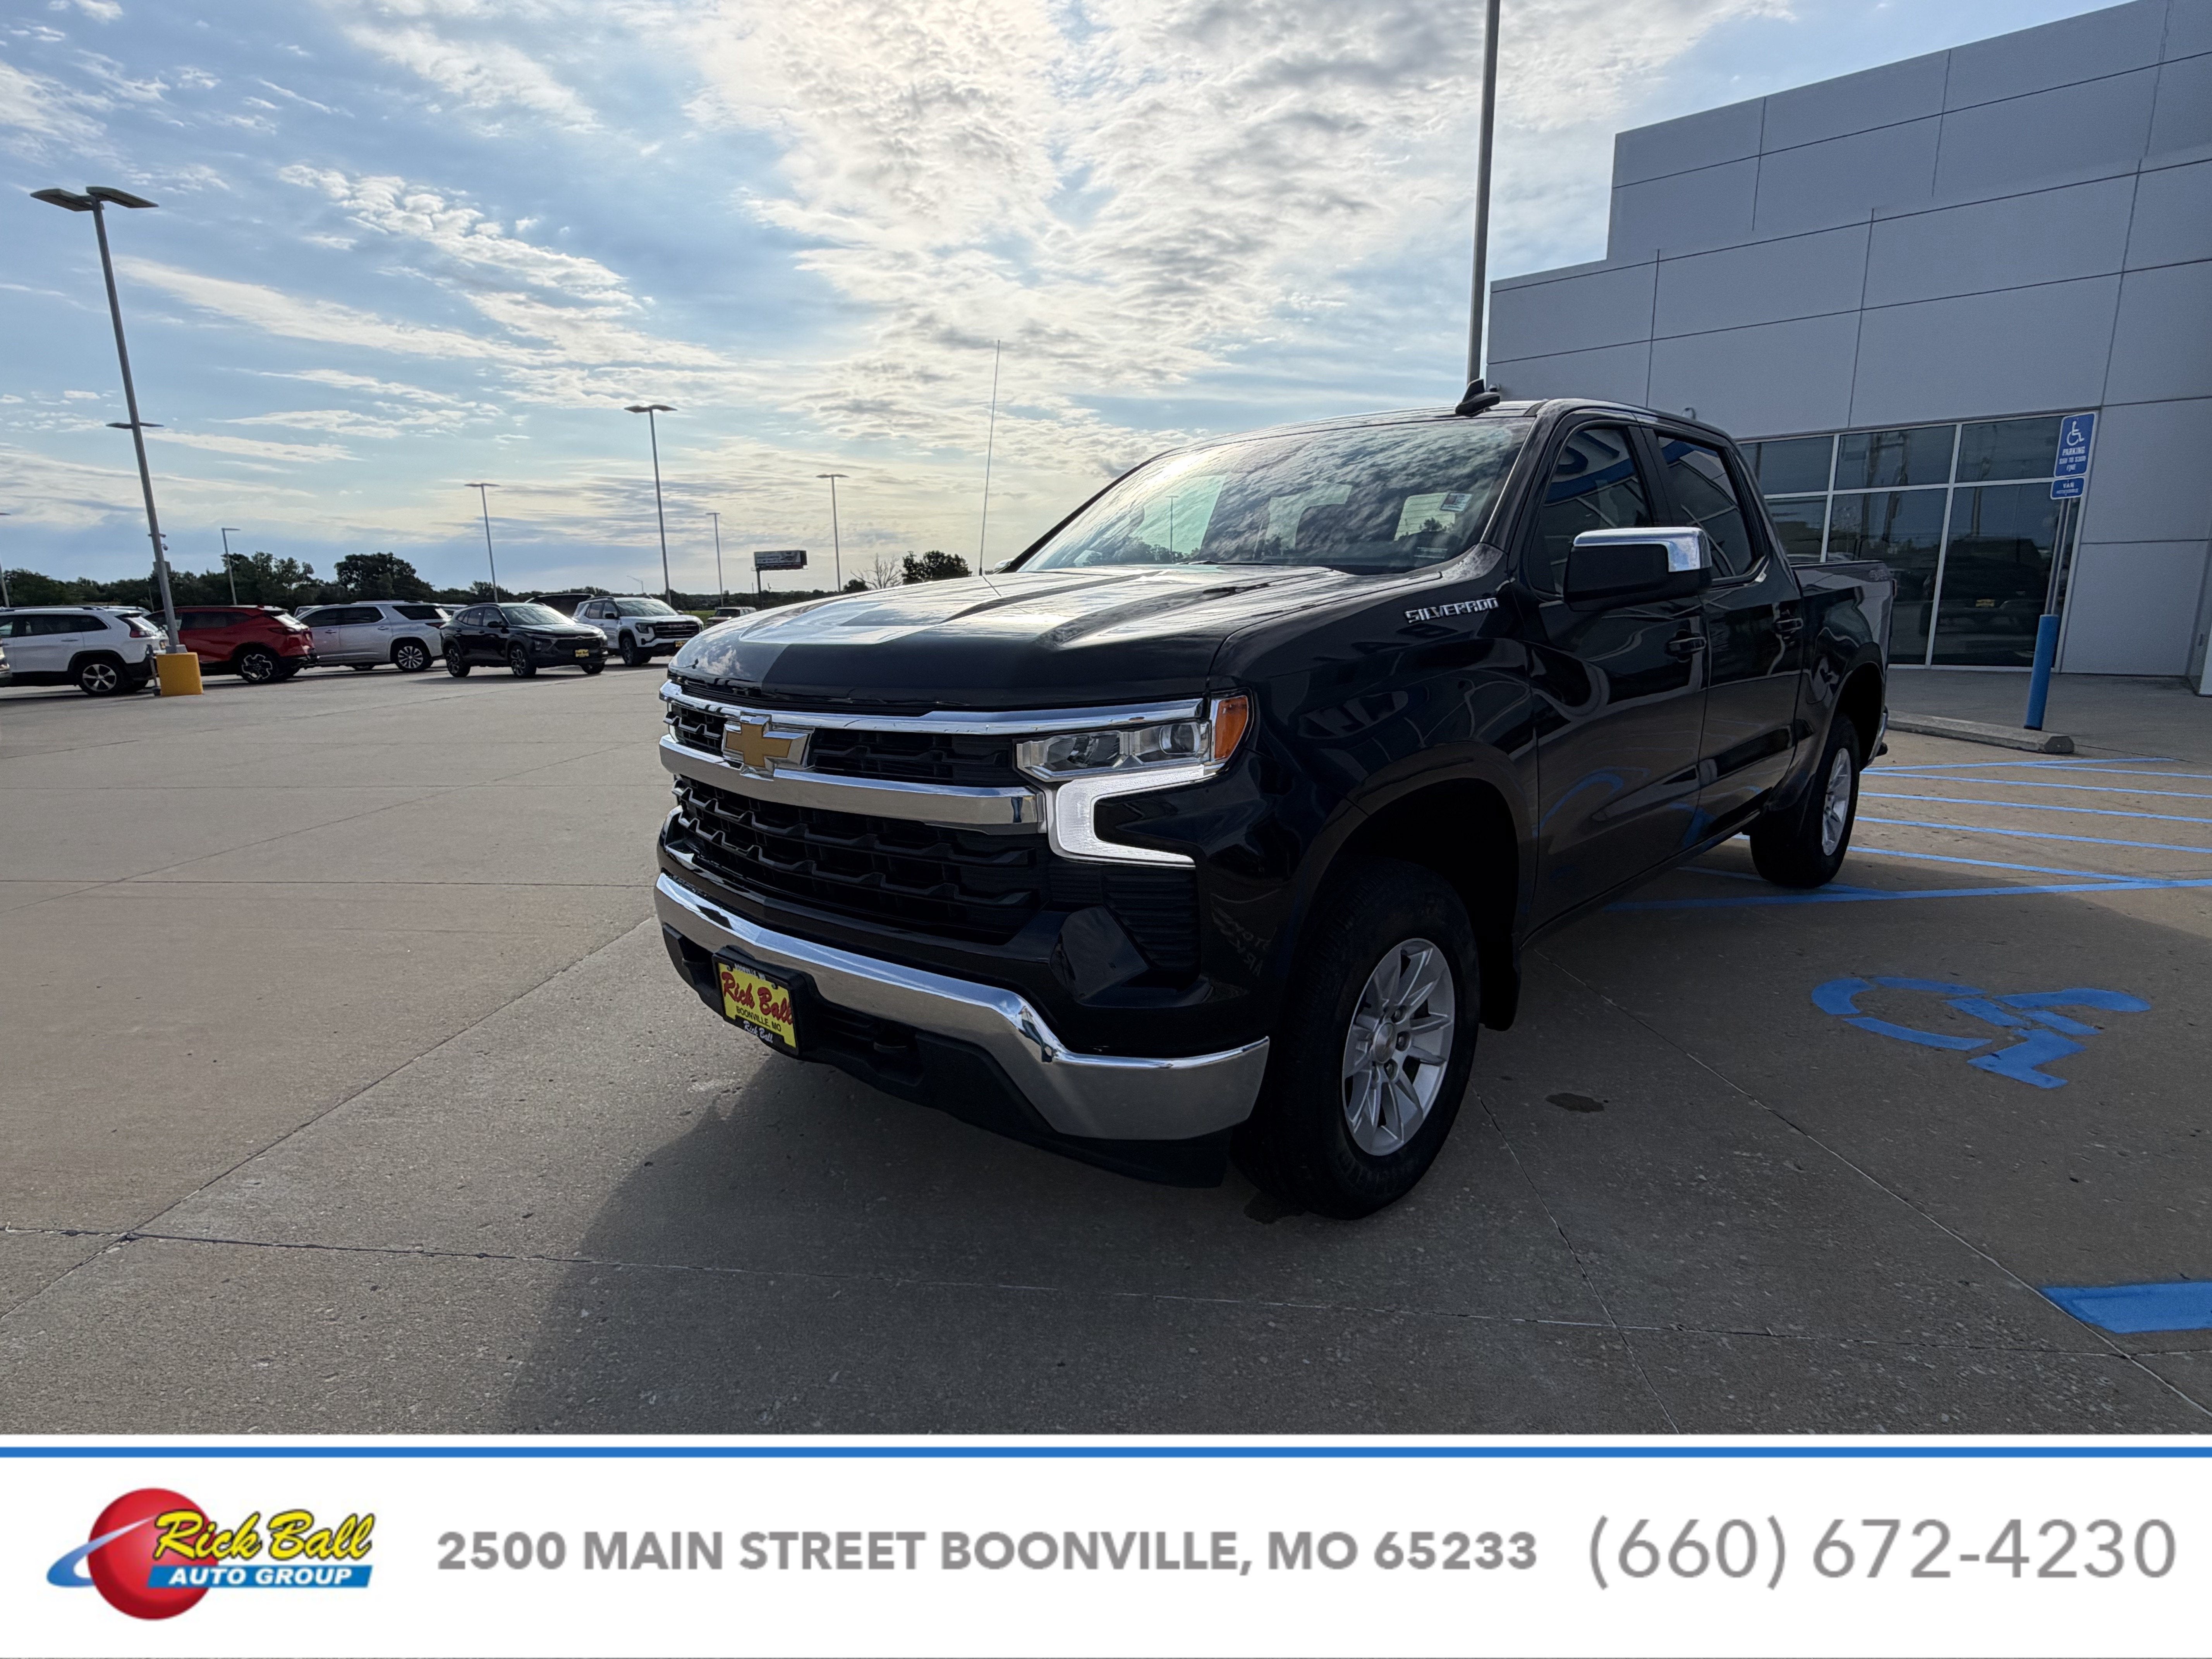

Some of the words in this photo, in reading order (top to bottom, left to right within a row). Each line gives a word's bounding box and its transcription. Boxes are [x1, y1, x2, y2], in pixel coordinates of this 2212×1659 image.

[2062, 446, 2085, 456] PARKING
[1404, 598, 1499, 623] SILVERADO
[721, 971, 755, 1009] Rick
[757, 986, 794, 1025] Ball
[743, 1020, 758, 1036] Rick
[759, 1027, 773, 1044] Ball
[771, 1021, 781, 1032] MO
